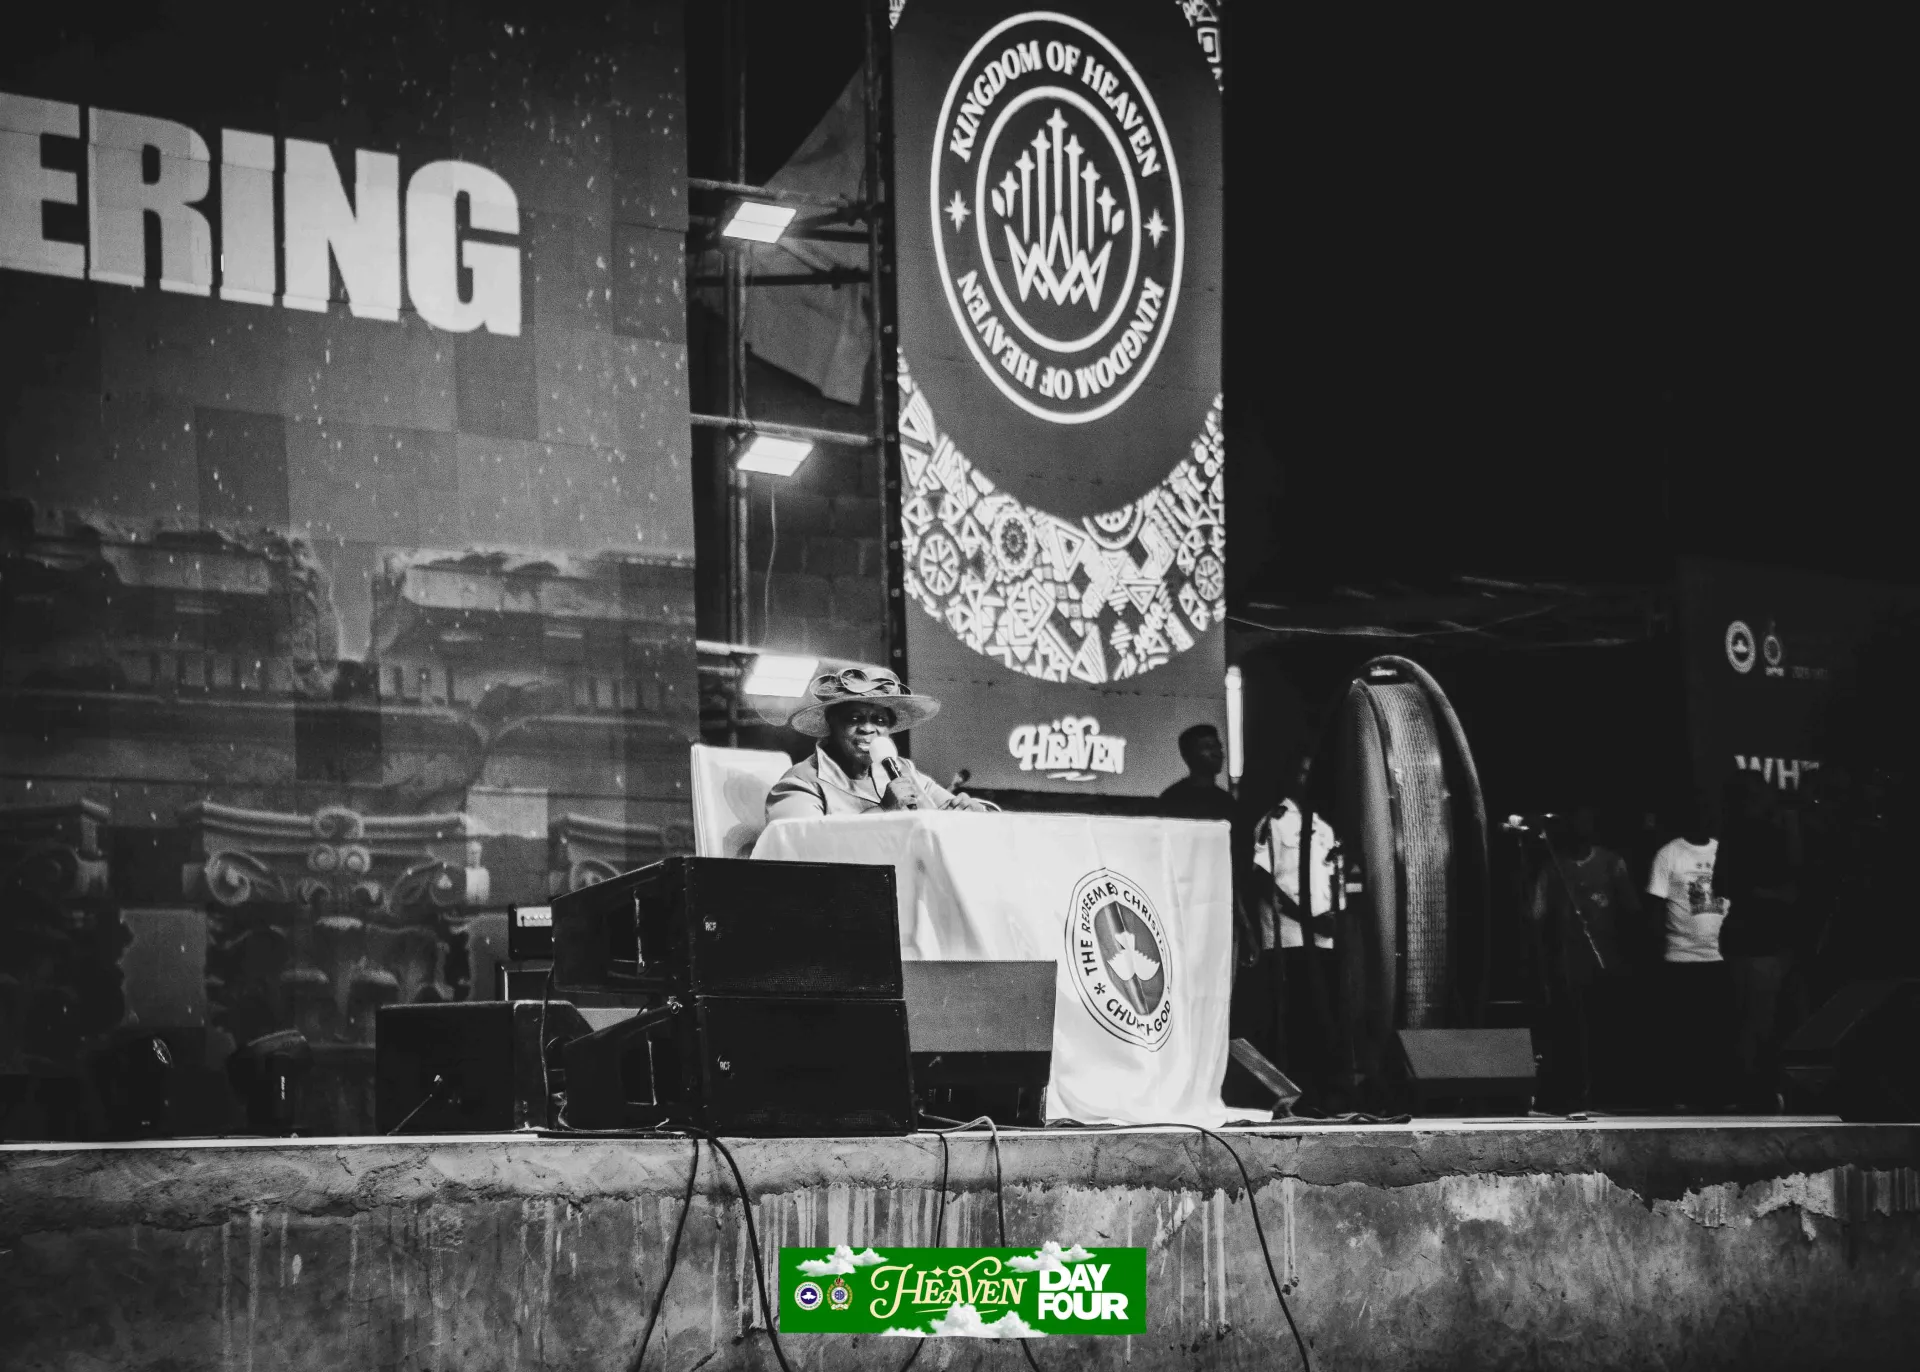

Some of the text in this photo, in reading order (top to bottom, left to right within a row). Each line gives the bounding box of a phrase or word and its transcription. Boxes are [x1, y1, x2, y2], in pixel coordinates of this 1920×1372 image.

[951, 40, 1161, 178] KINGDOM OF HEAVEN
[0, 91, 521, 337] ERING
[957, 270, 1165, 400] KINGDOM OF HEAVEN
[1009, 715, 1127, 774] HEAVEN
[1081, 939, 1098, 976] THE
[1154, 1000, 1170, 1032] GOD
